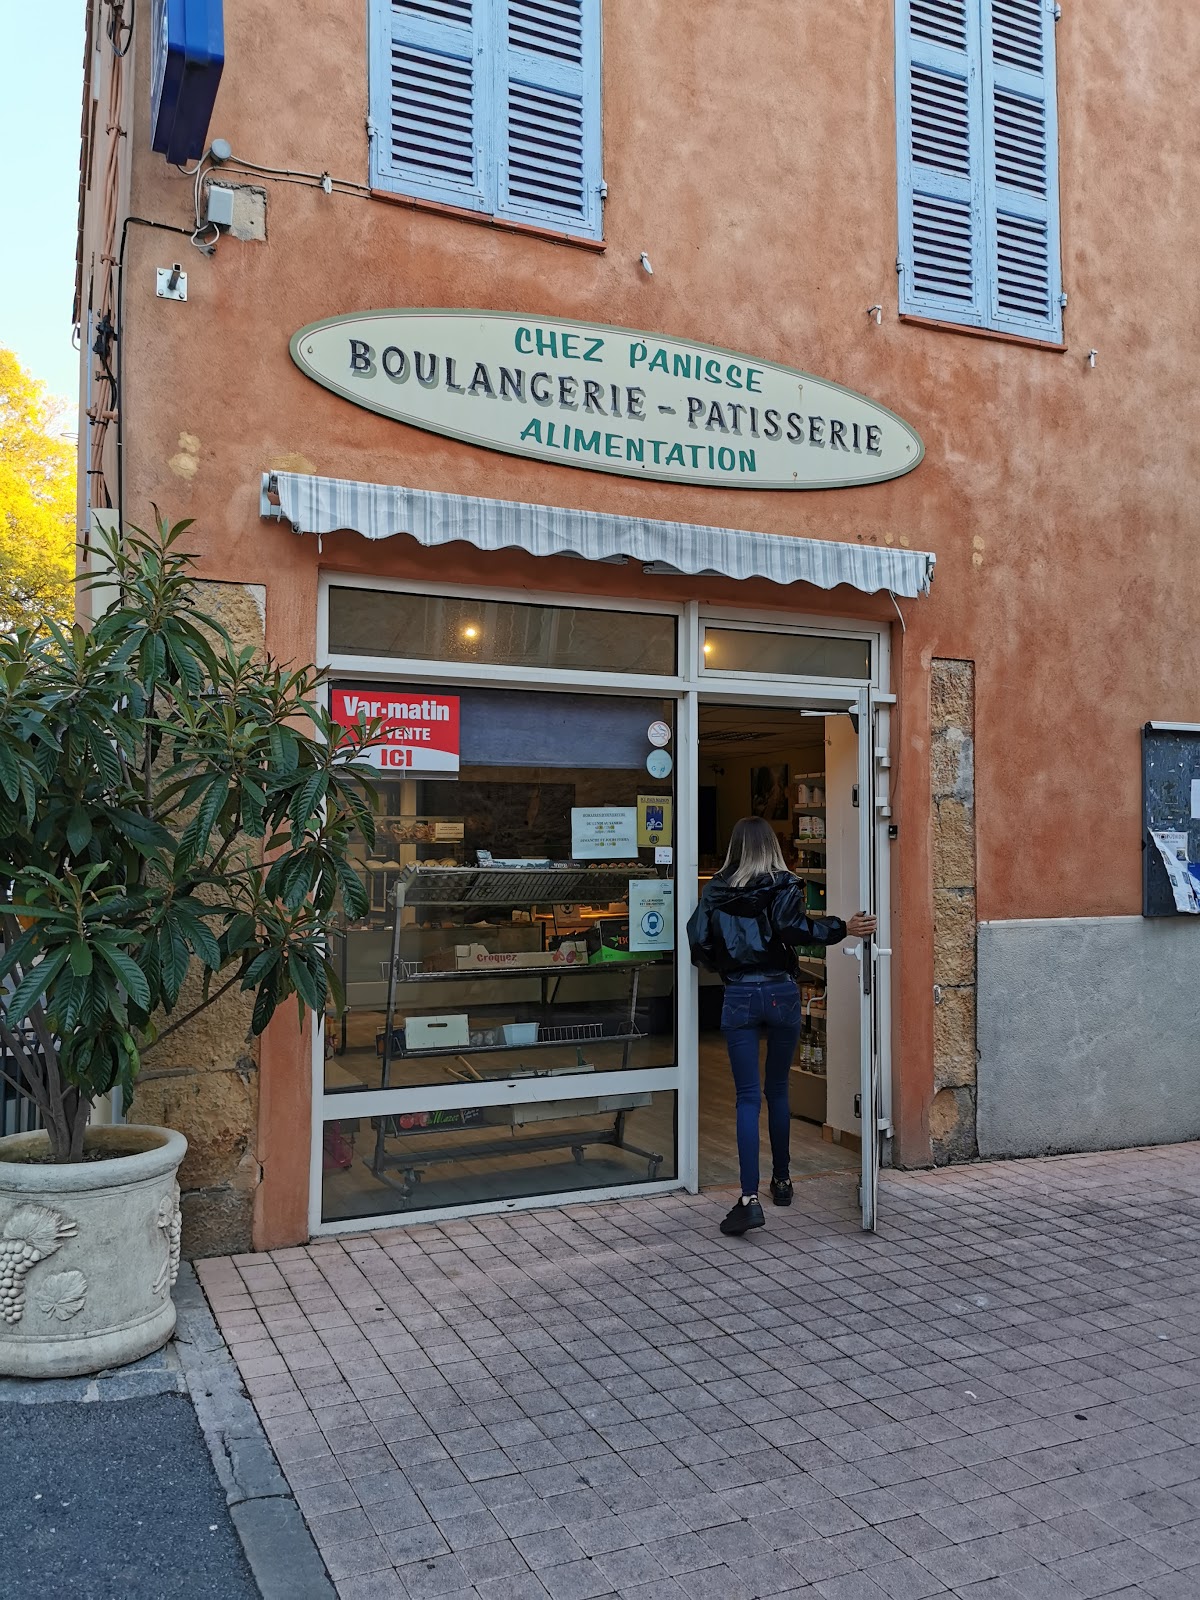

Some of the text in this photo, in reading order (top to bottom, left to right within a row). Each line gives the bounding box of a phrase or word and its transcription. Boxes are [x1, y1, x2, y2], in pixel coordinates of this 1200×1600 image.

[515, 327, 764, 393] CHEZ PANISSE
[349, 339, 646, 421] BOULANGERIE
[687, 396, 882, 457] PATISSERIE
[520, 418, 757, 472] ALIMENTATION
[385, 726, 431, 740] VENTE
[381, 749, 413, 767] ICI
[476, 953, 518, 963] Croquez
